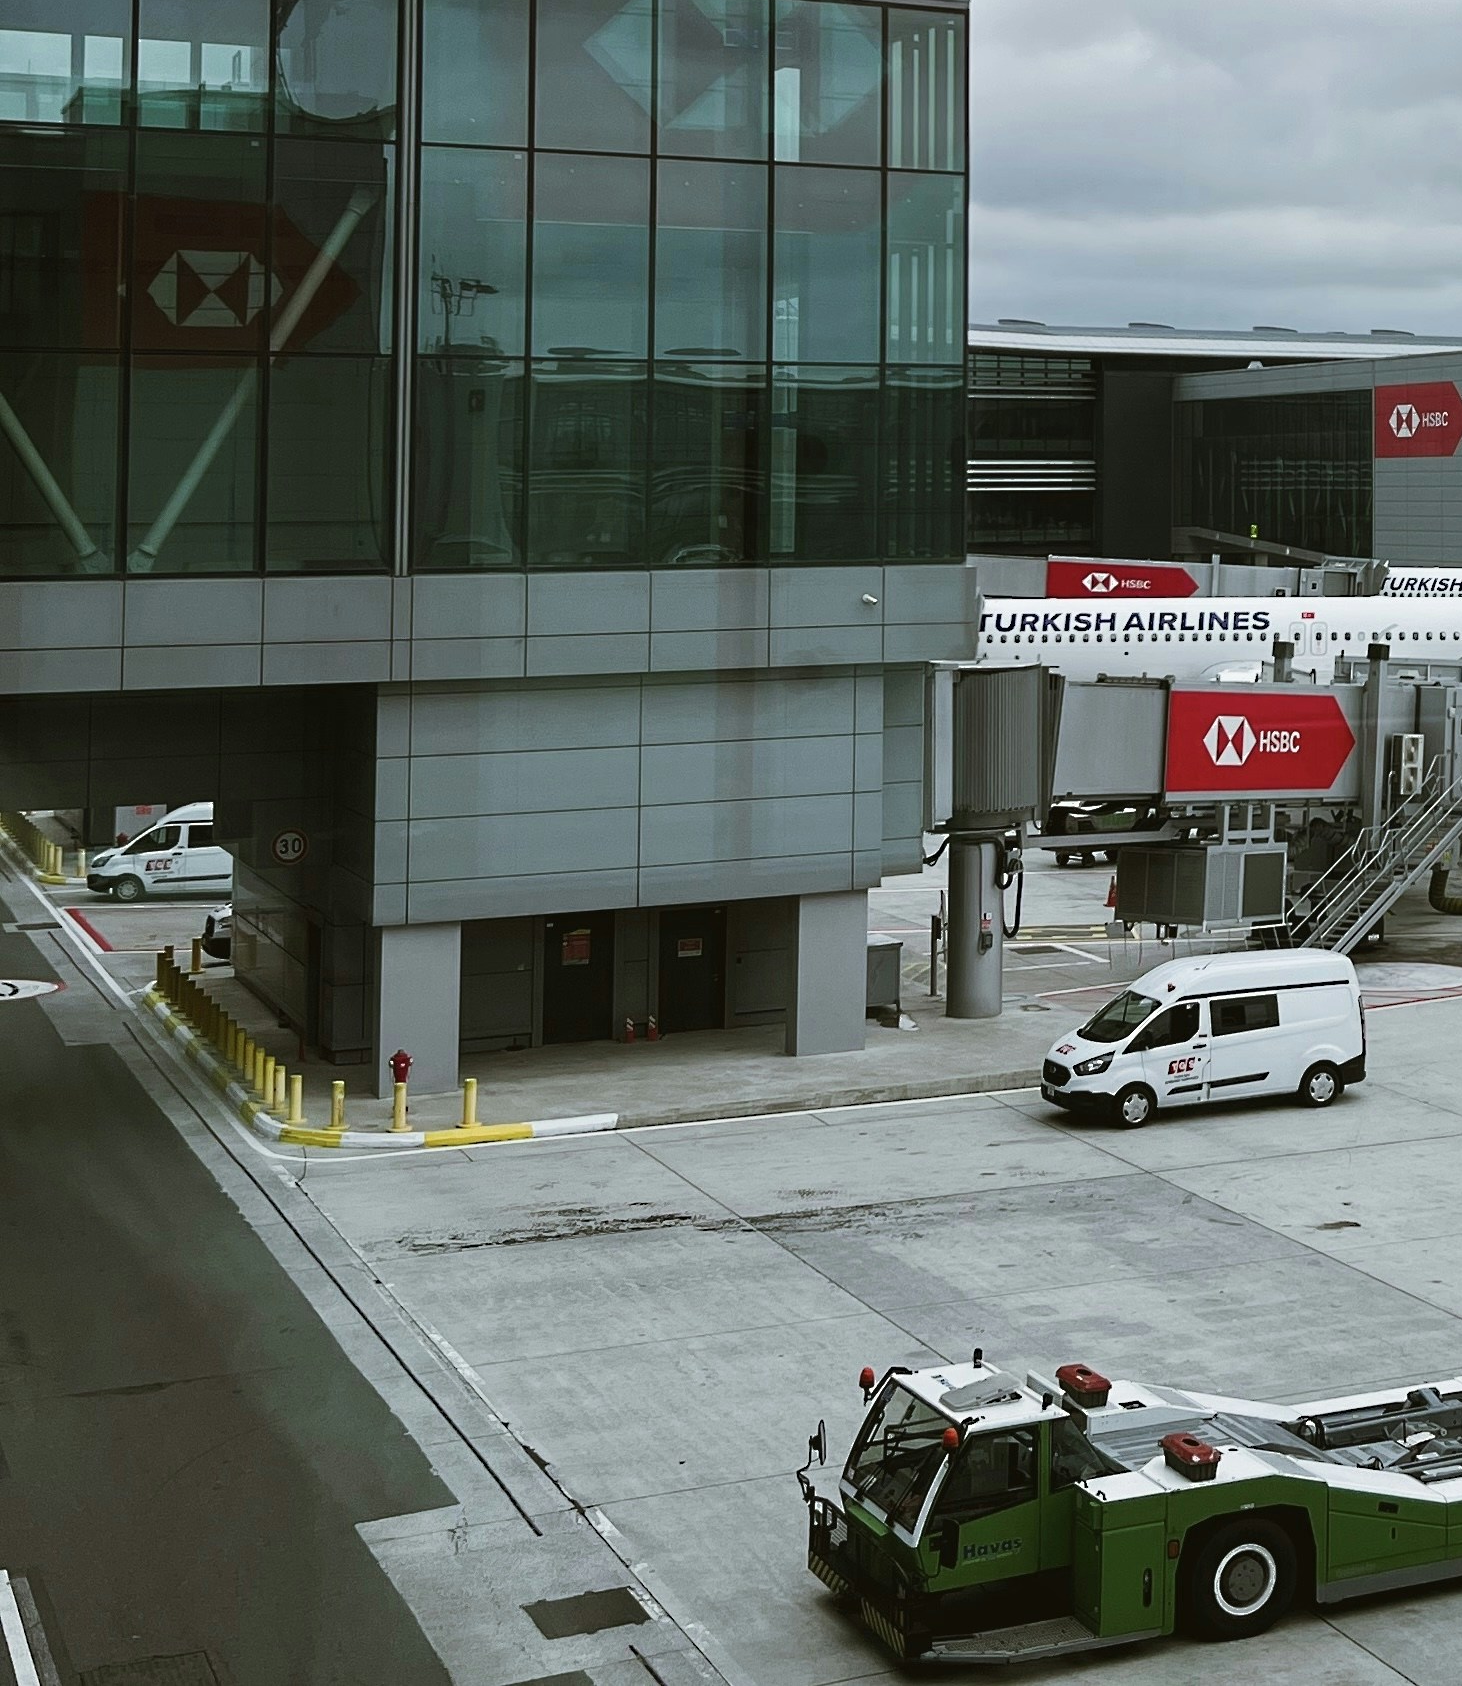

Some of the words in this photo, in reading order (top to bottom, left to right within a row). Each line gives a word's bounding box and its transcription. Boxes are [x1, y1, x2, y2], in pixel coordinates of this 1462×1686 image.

[1421, 411, 1449, 427] HSBC
[1121, 579, 1151, 590] HSBC
[979, 612, 1116, 633] TURKISH
[1122, 611, 1270, 632] AIRLINES
[1259, 730, 1301, 753] HSBC
[279, 837, 302, 855] 30
